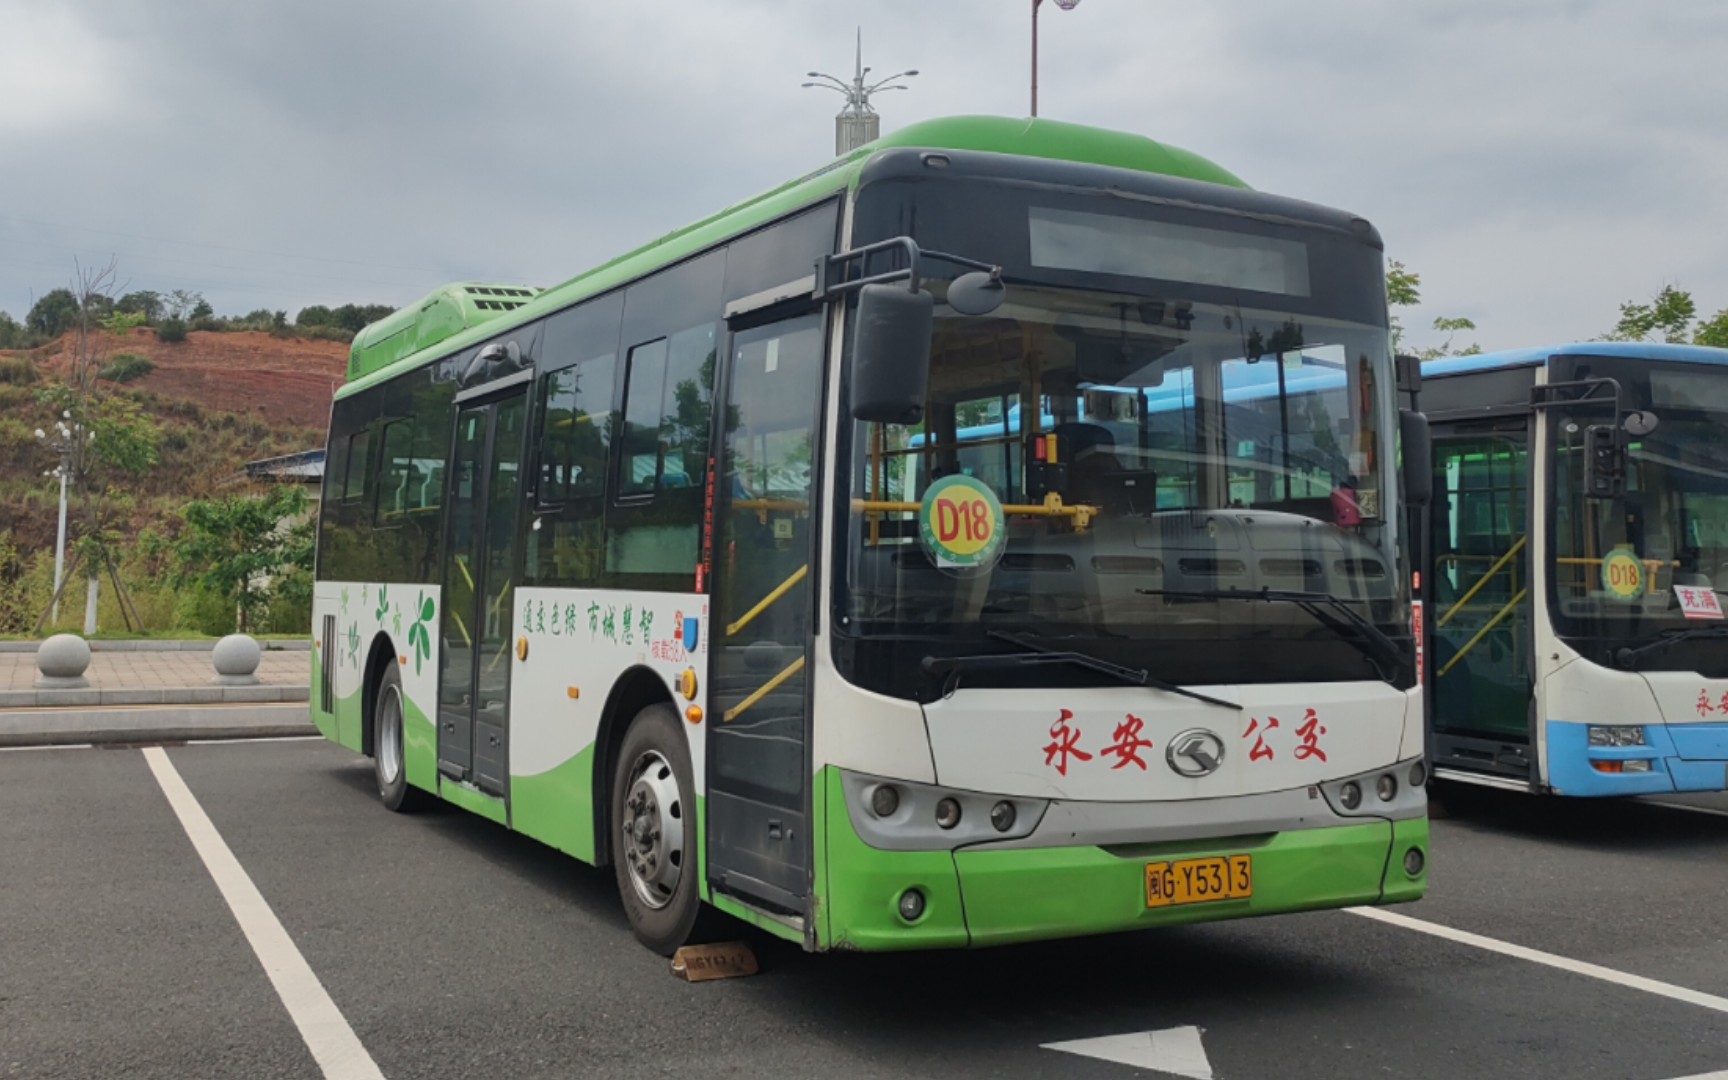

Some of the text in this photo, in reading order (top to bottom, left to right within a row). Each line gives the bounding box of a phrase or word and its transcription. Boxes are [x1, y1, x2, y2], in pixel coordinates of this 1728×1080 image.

[937, 498, 990, 542] D18
[1610, 563, 1638, 586] D18
[1680, 588, 1717, 610] 充满
[1042, 708, 1327, 776] 永安 公交
